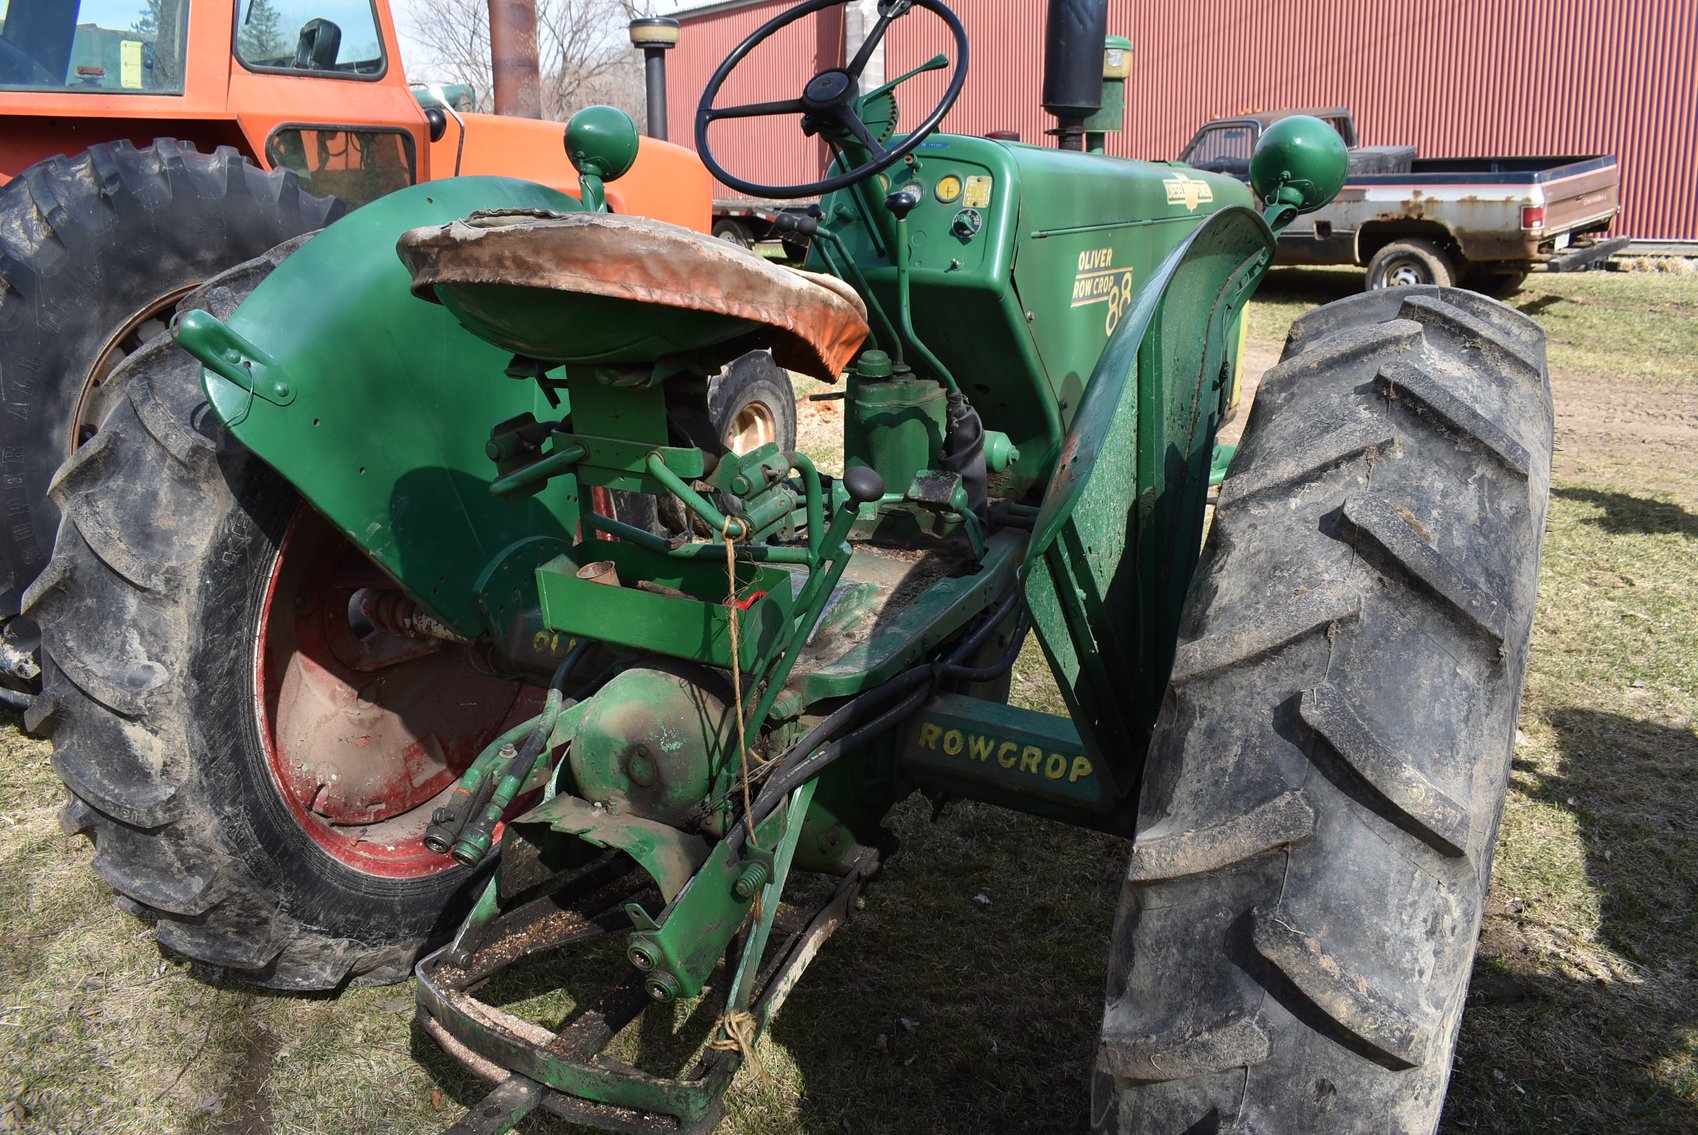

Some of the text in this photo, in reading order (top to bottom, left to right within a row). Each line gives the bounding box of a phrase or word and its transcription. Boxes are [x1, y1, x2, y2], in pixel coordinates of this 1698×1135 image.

[1078, 247, 1113, 271] OLIVER
[1072, 275, 1115, 299] ROW CROP
[1105, 271, 1133, 337] 88
[918, 721, 1093, 783] ROWCROP
